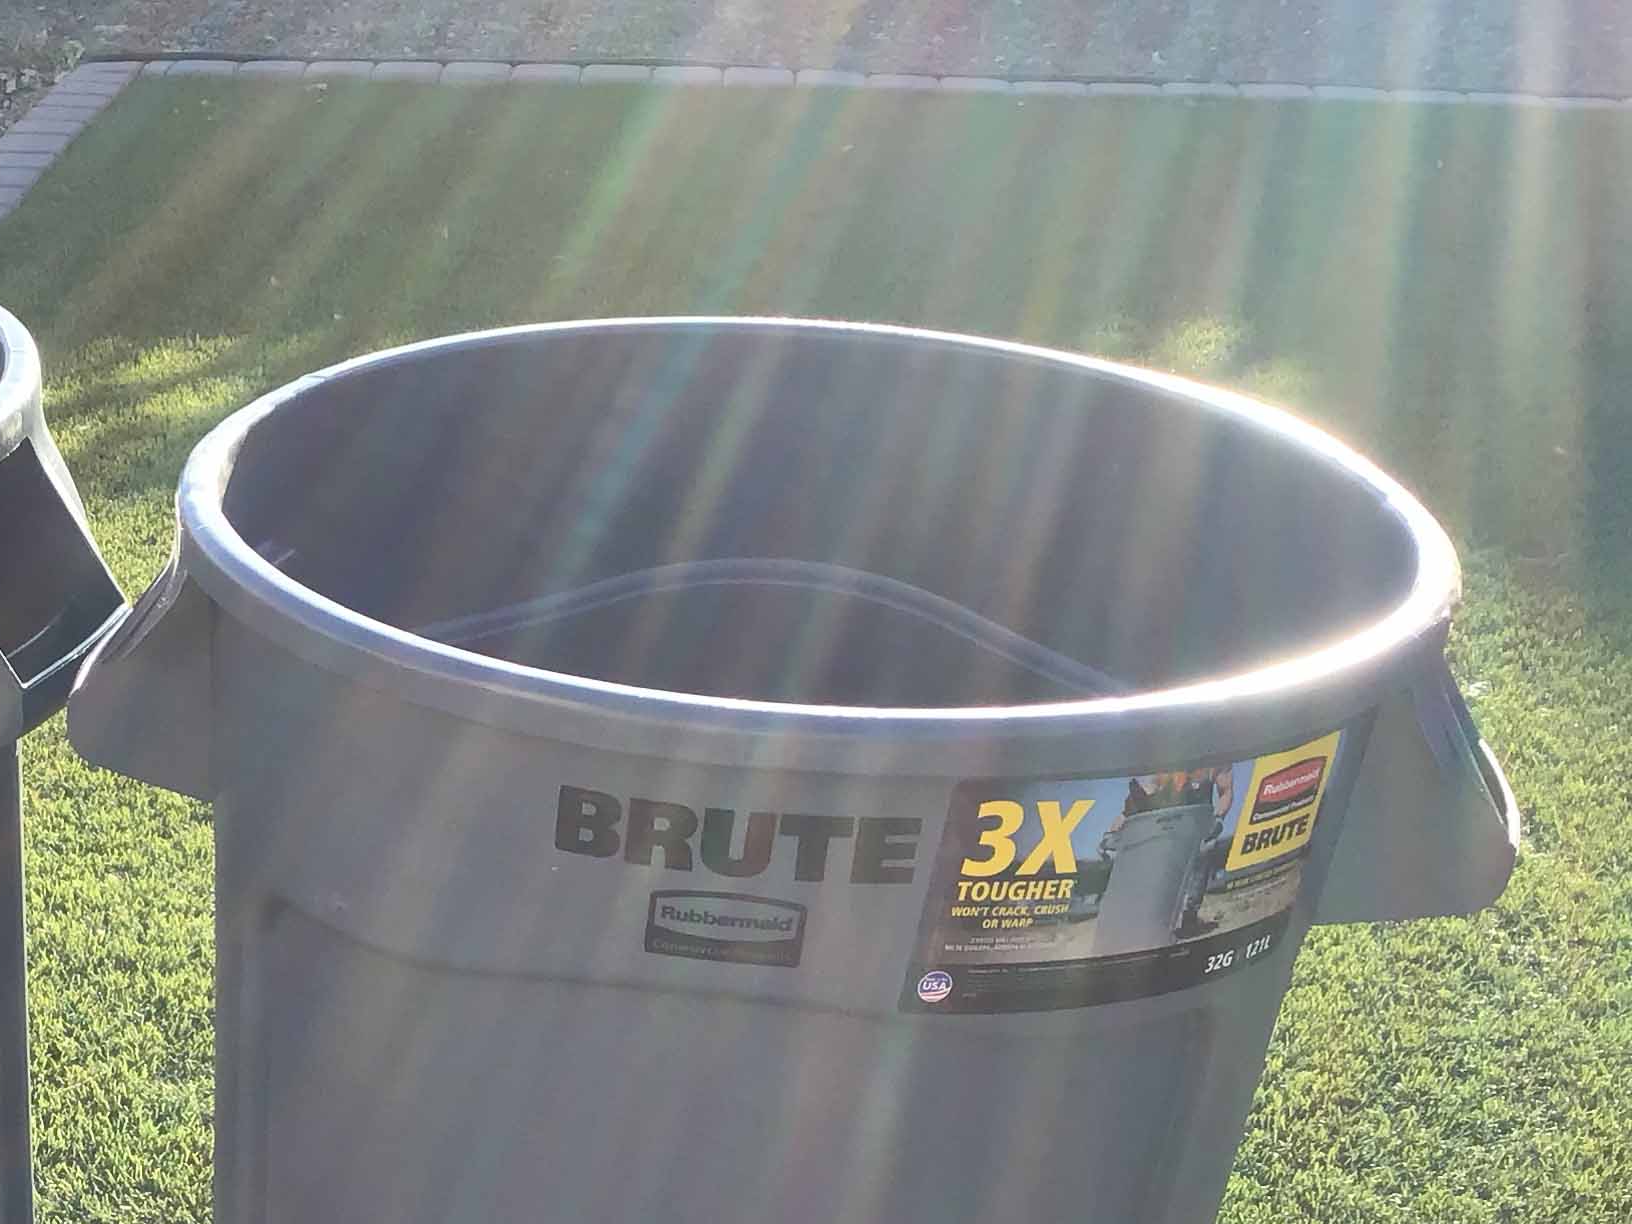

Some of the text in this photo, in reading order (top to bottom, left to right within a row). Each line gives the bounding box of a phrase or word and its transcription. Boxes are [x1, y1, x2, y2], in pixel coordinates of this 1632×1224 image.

[1264, 768, 1320, 796] Rubbermaid
[555, 785, 923, 884] BRUTE
[959, 800, 1096, 877] 3X
[1240, 813, 1311, 856] BRUTE
[957, 879, 1074, 902] TOUGHER
[660, 905, 794, 931] Rubbermaid
[951, 906, 989, 917] WON'T
[1034, 904, 1070, 915] CRUSH
[982, 918, 1033, 929] OR WARP
[1204, 935, 1271, 974] 32G 121L
[922, 981, 948, 992] USA
